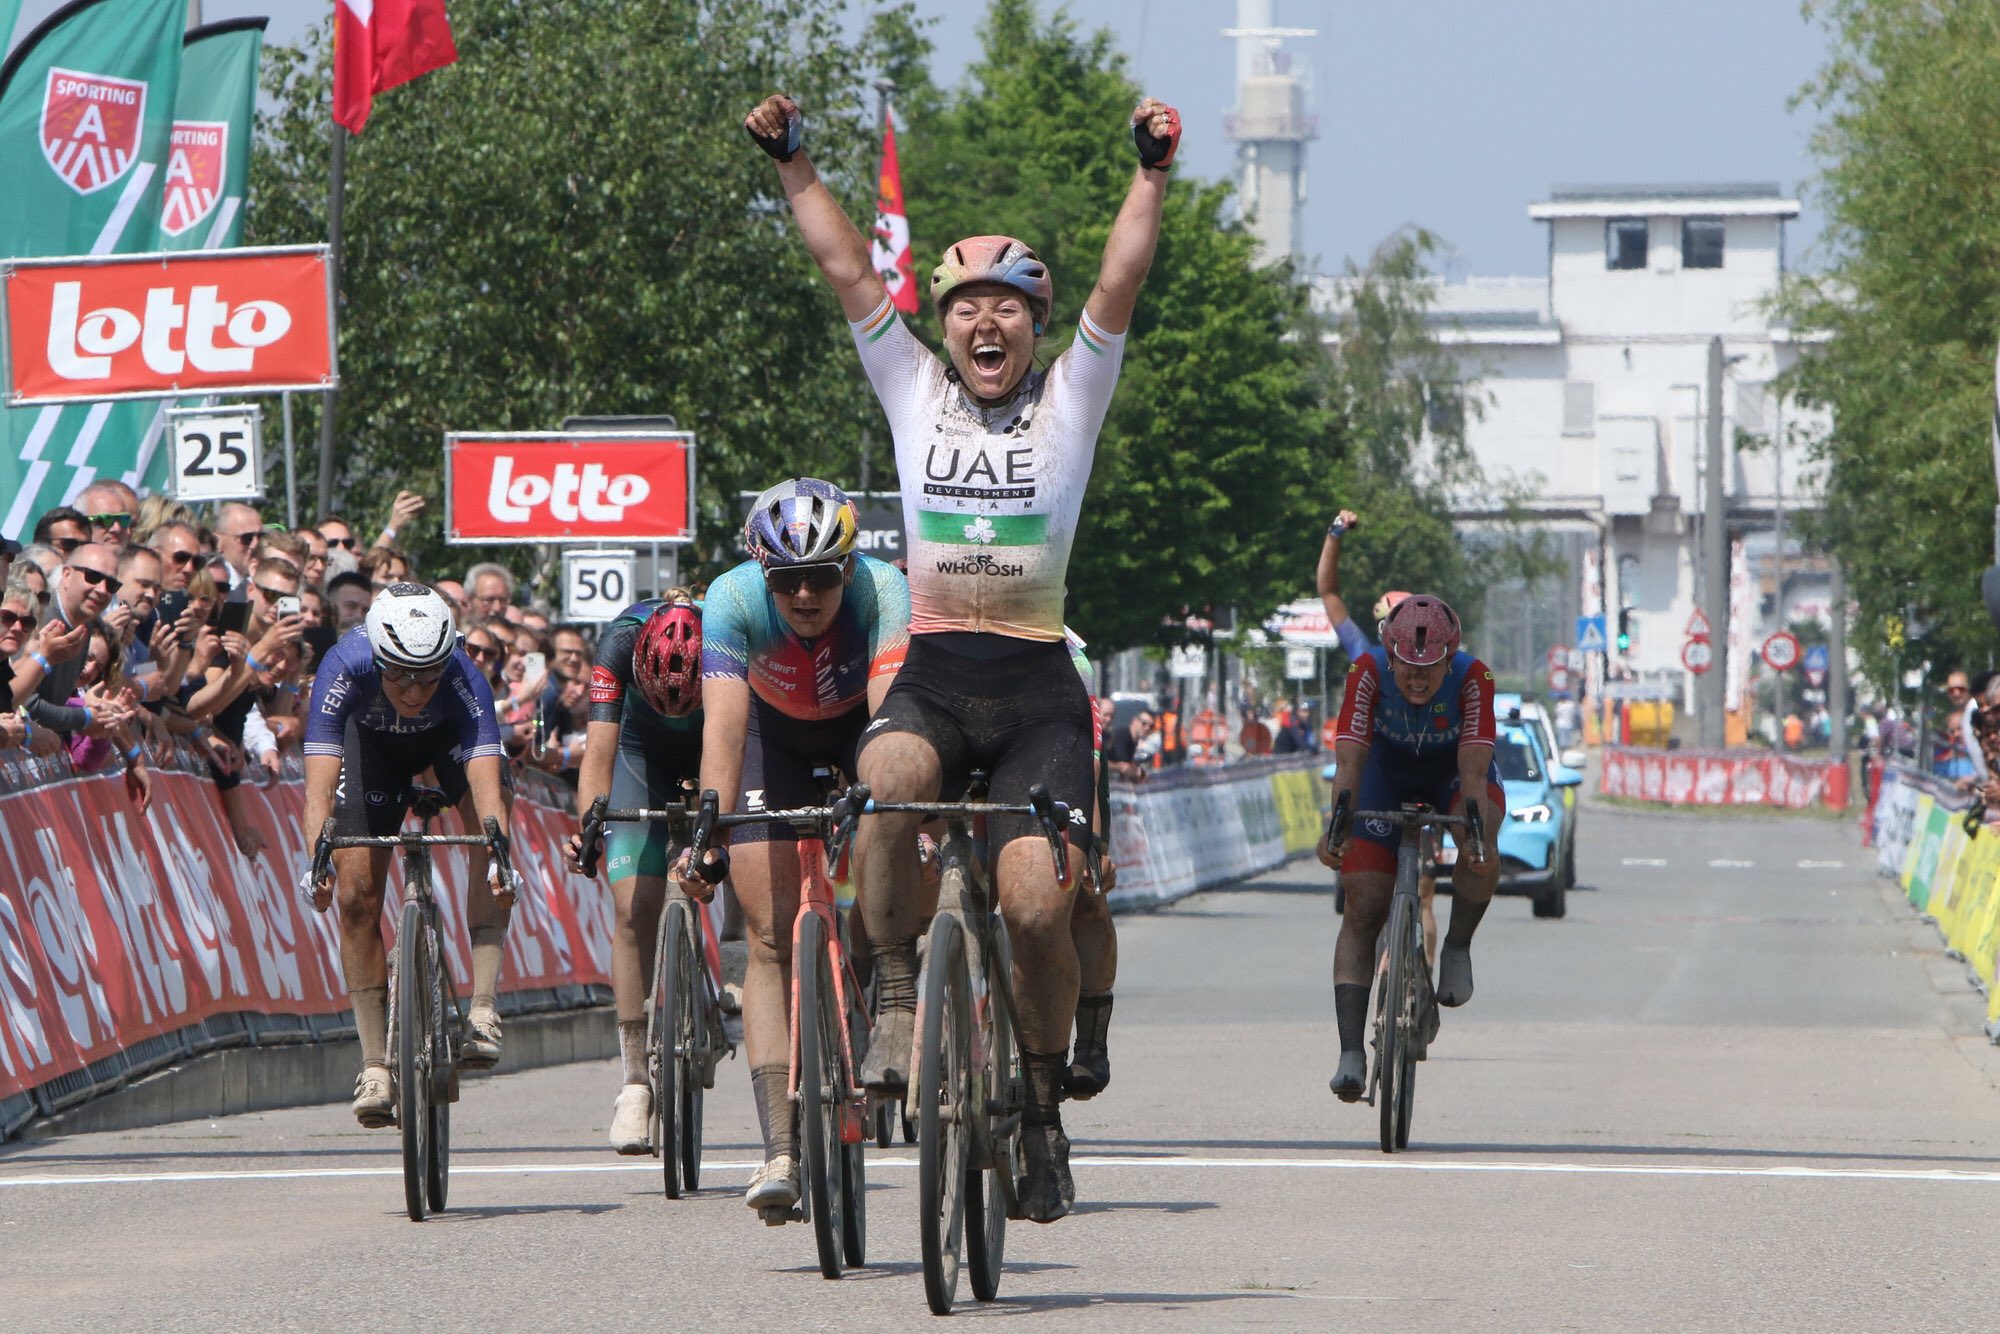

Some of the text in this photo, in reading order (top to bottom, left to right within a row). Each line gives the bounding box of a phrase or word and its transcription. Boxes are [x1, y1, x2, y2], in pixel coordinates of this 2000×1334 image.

[55, 78, 136, 106] SPORTING
[172, 130, 218, 146] RTING
[182, 432, 247, 477] 25
[925, 444, 1036, 485] UAE
[925, 498, 1033, 509] TEAM
[927, 486, 1031, 497] DEVELOPMENT
[936, 560, 1024, 577] WHOOSH
[576, 569, 624, 602] 50
[321, 671, 352, 716] FENIX
[1350, 670, 1378, 736] CERATIZIT
